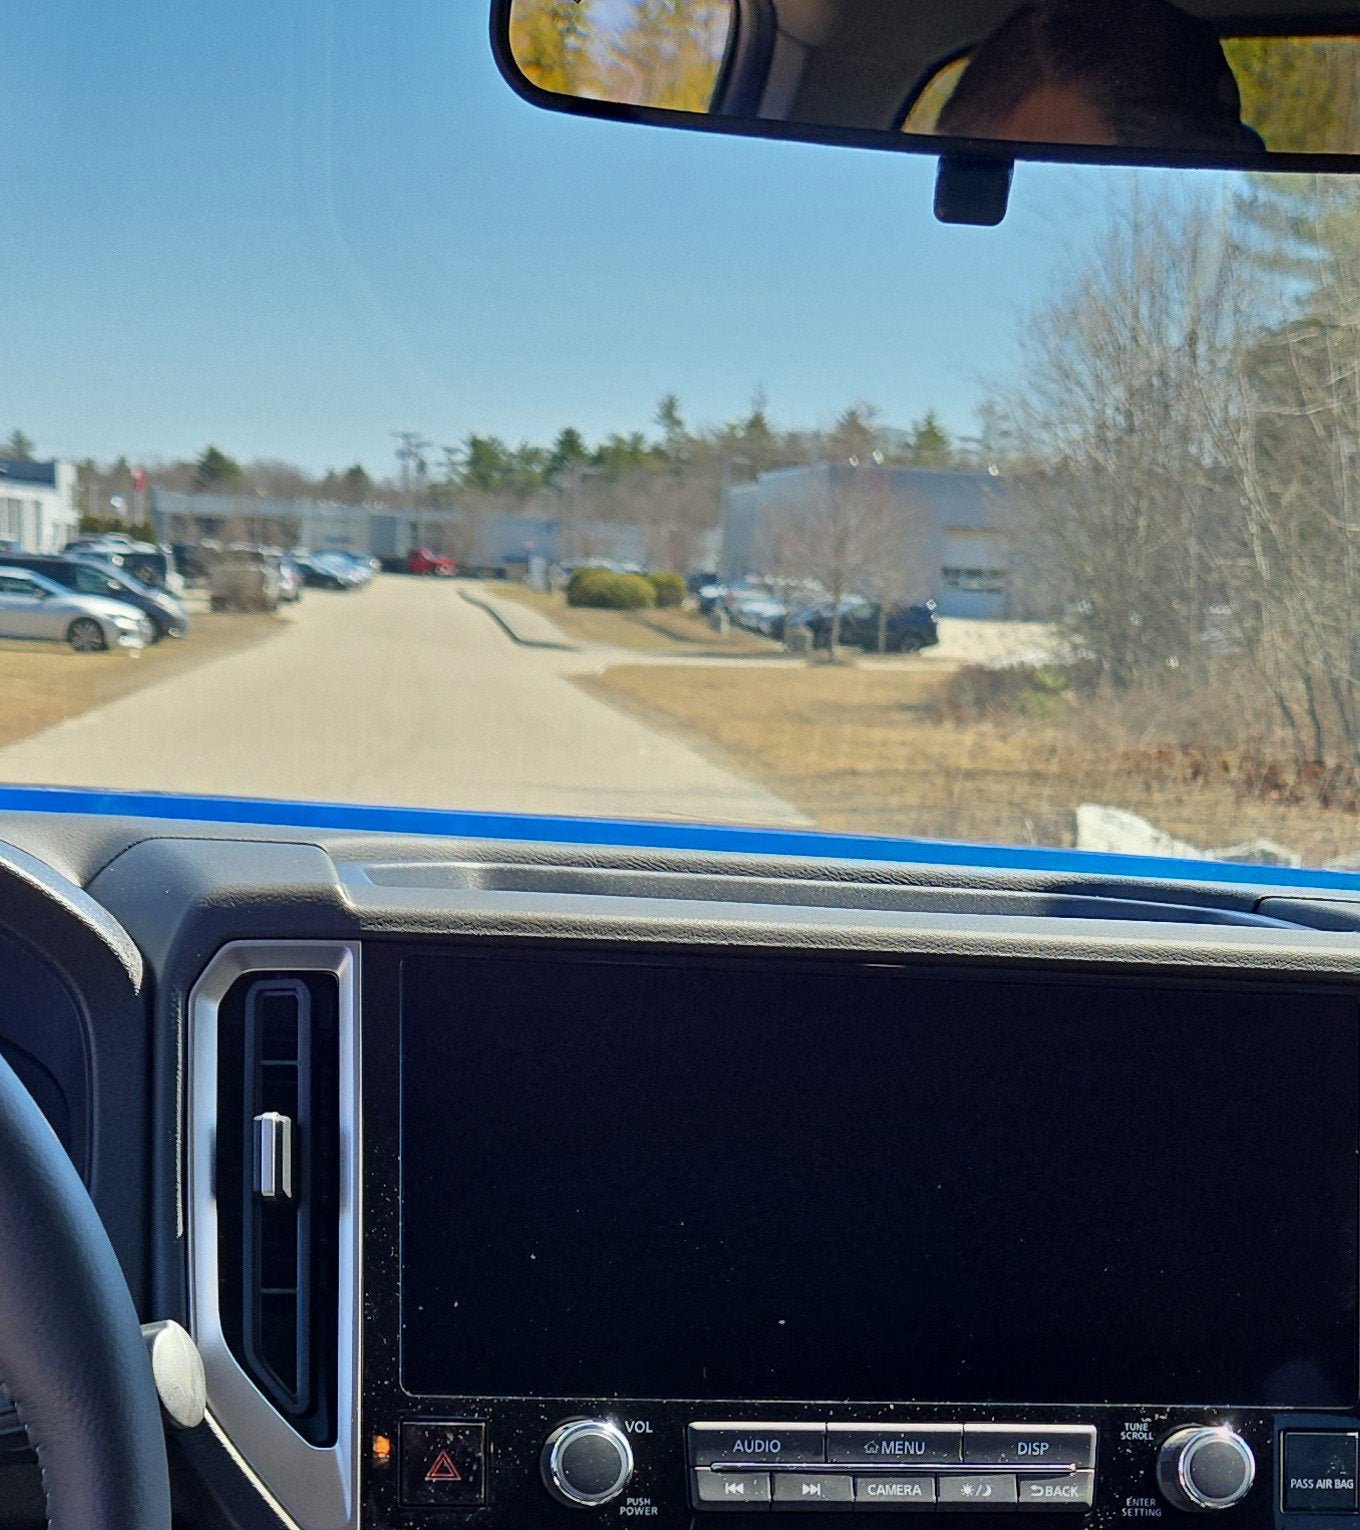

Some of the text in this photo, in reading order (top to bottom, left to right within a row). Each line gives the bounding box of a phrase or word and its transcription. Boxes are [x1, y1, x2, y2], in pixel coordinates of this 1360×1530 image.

[624, 1420, 654, 1434] VOL
[1124, 1422, 1149, 1431] TUNE
[1120, 1431, 1154, 1441] SCROLL
[732, 1439, 782, 1453] AUDIO
[880, 1441, 926, 1456] MENU
[1017, 1442, 1049, 1456] DISP
[1290, 1479, 1354, 1490] PASS AIR BAG
[867, 1484, 922, 1497] CAMERA
[1045, 1485, 1080, 1497] BACK
[626, 1497, 651, 1506] PUSH
[1126, 1498, 1156, 1508] ENTER
[619, 1506, 658, 1516] POWER
[1120, 1508, 1162, 1518] SETTING
